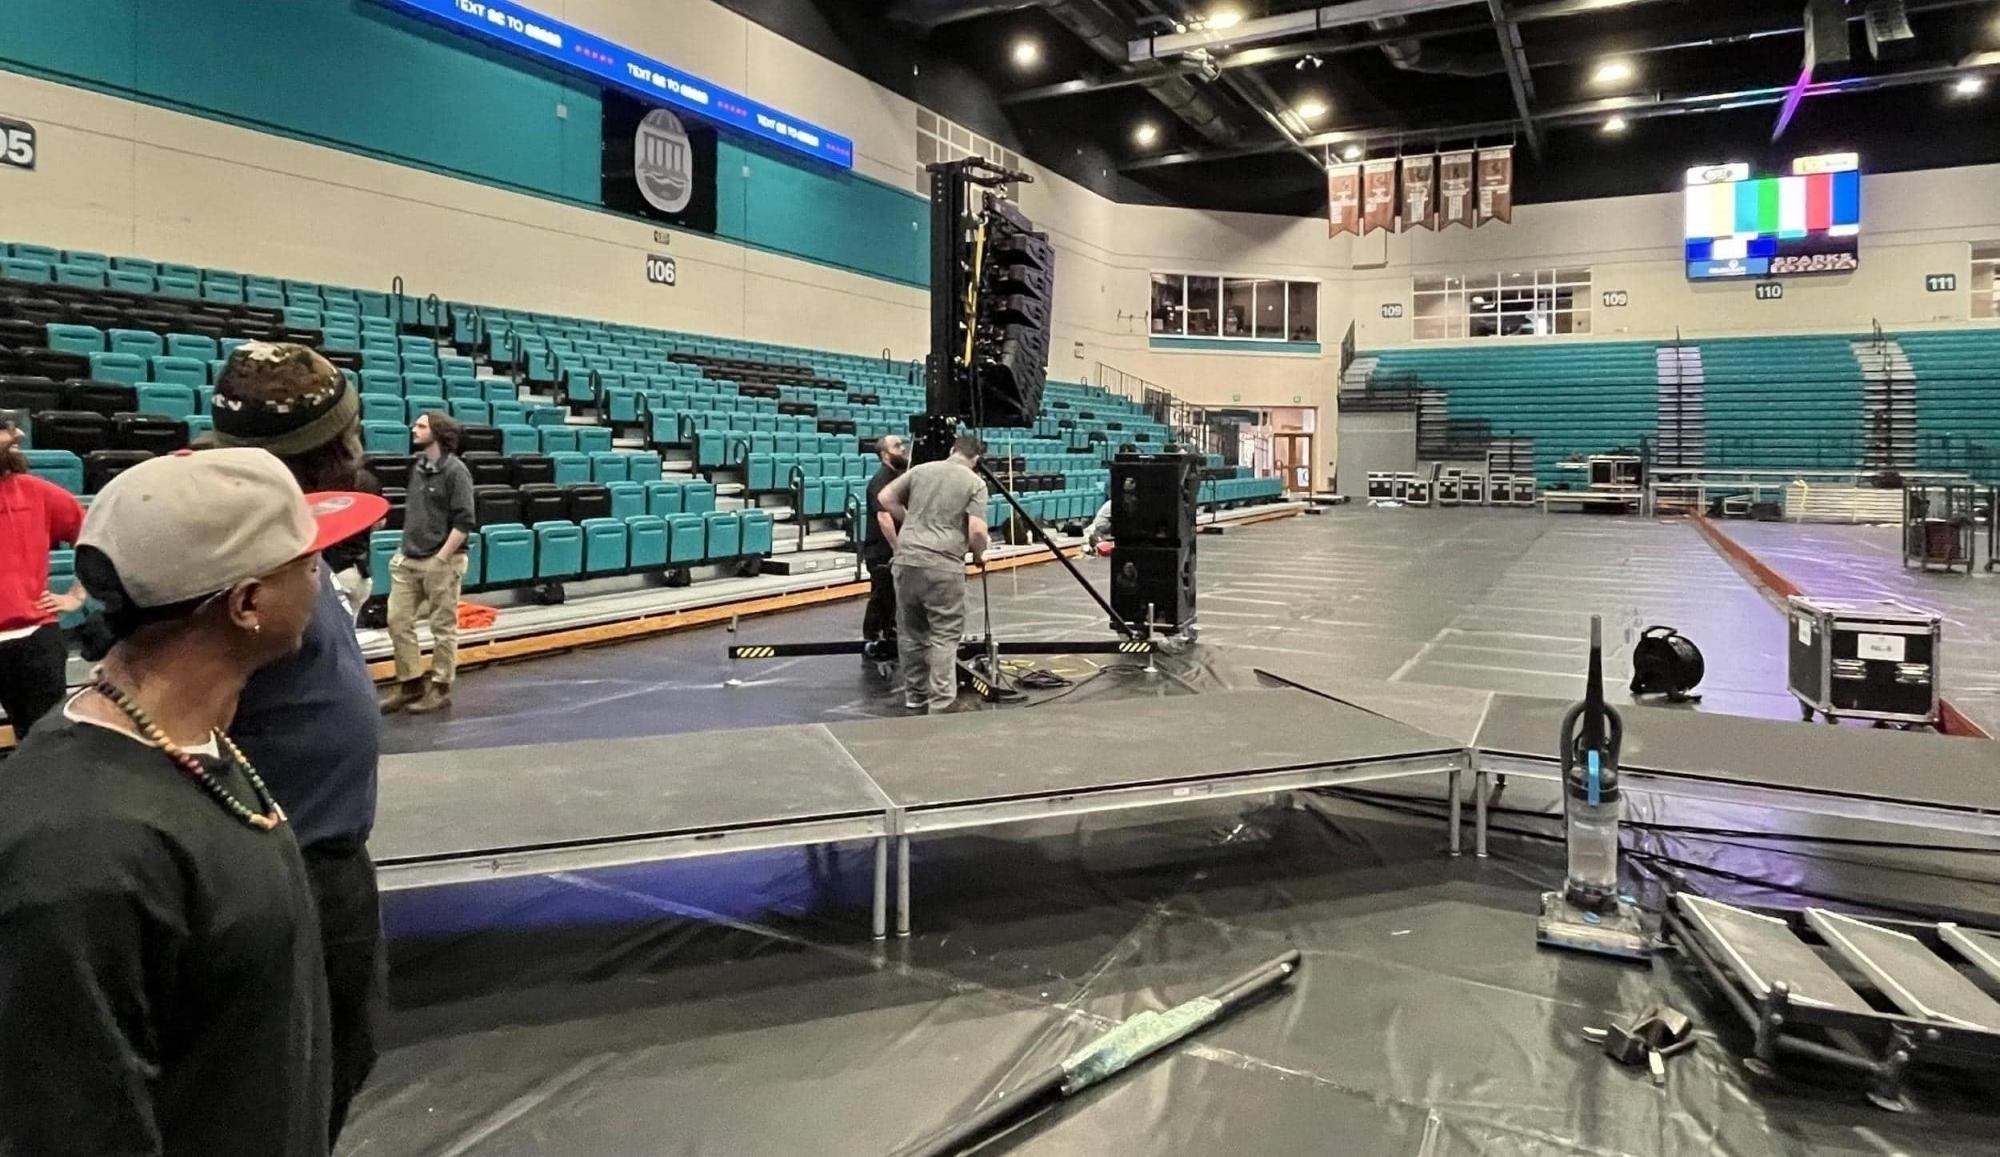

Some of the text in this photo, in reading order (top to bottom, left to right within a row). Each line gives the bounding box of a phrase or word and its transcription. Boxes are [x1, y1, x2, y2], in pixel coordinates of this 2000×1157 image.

[506, 15, 524, 33] TO
[647, 259, 675, 283] 106
[1928, 277, 1954, 290] 111
[1757, 285, 1782, 298] 110
